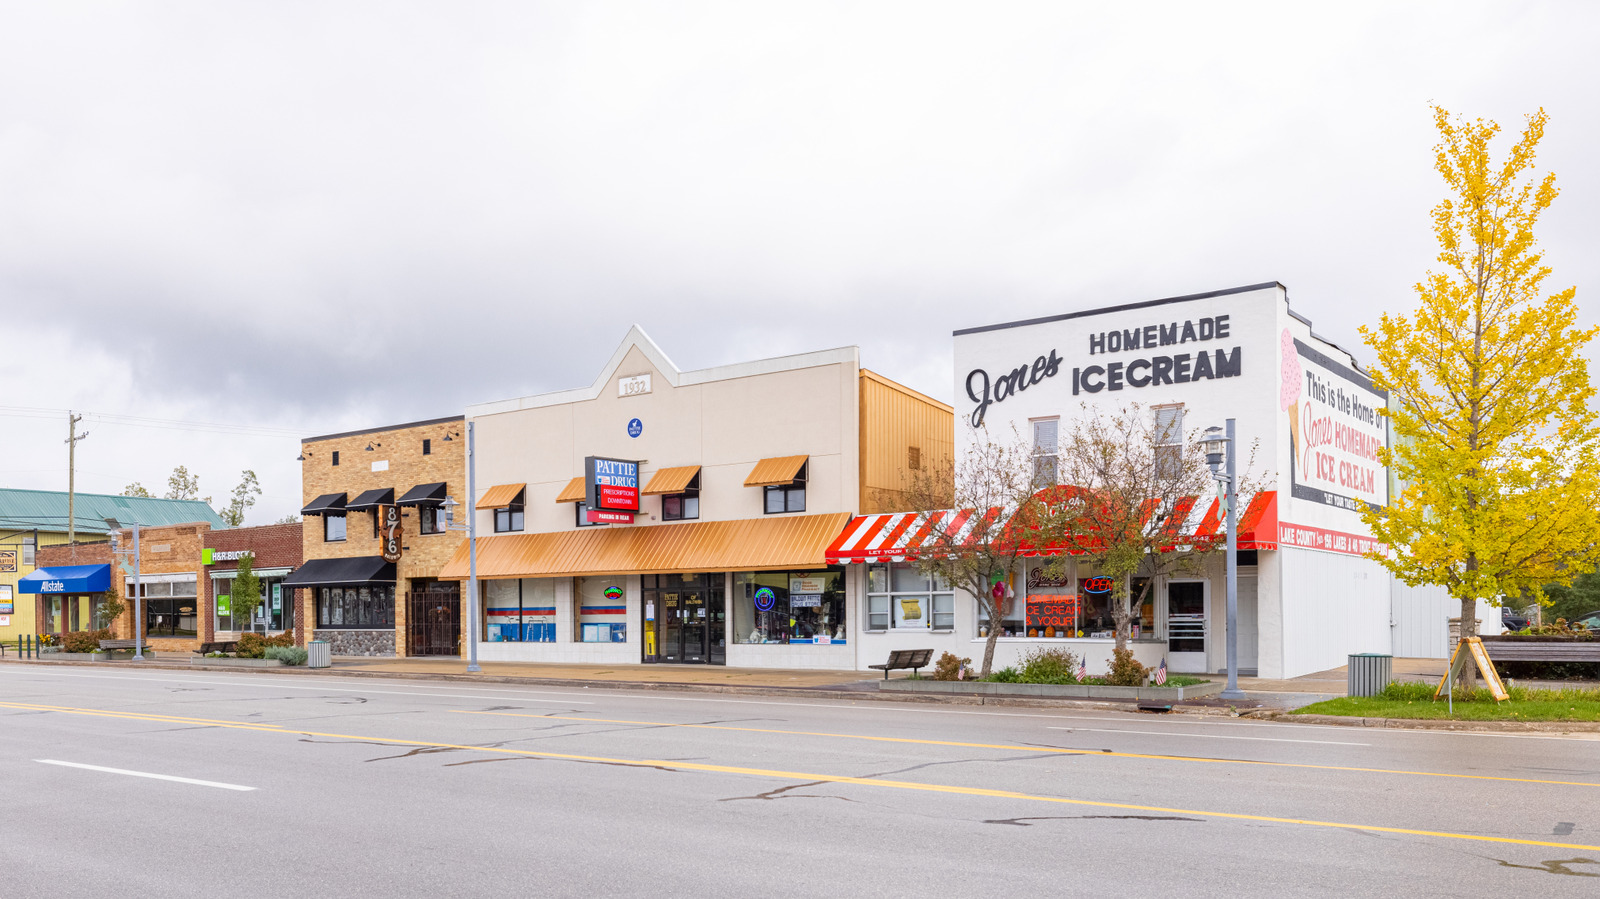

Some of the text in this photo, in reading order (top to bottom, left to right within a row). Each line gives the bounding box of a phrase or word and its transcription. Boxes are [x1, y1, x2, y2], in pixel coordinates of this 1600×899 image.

[1089, 314, 1230, 355] HOMEMADE
[624, 380, 647, 394] 1932
[966, 349, 1063, 428] Jones
[1306, 370, 1326, 404] This
[1328, 381, 1336, 408] is
[1337, 388, 1350, 416] the
[1352, 394, 1374, 426] Home
[1303, 401, 1382, 482] Jones HOMEMADE
[596, 460, 636, 476] PATTIE
[1316, 451, 1374, 494] ICE CREAM
[610, 476, 636, 488] DRUG
[604, 488, 634, 496] PRESCRIPTIONS
[1334, 495, 1344, 507] YOUR
[387, 507, 400, 554] 876
[1280, 526, 1295, 544] LAKE
[1296, 529, 1316, 547] COUNTY
[1333, 535, 1346, 551] LAKES
[212, 552, 226, 561] H&R
[40, 580, 64, 592] Allstate
[1084, 578, 1114, 591] OPEN
[1022, 594, 1082, 604] HOMEMADE
[1025, 605, 1081, 615] CE CREAM
[1026, 616, 1079, 626] & YOGURT
